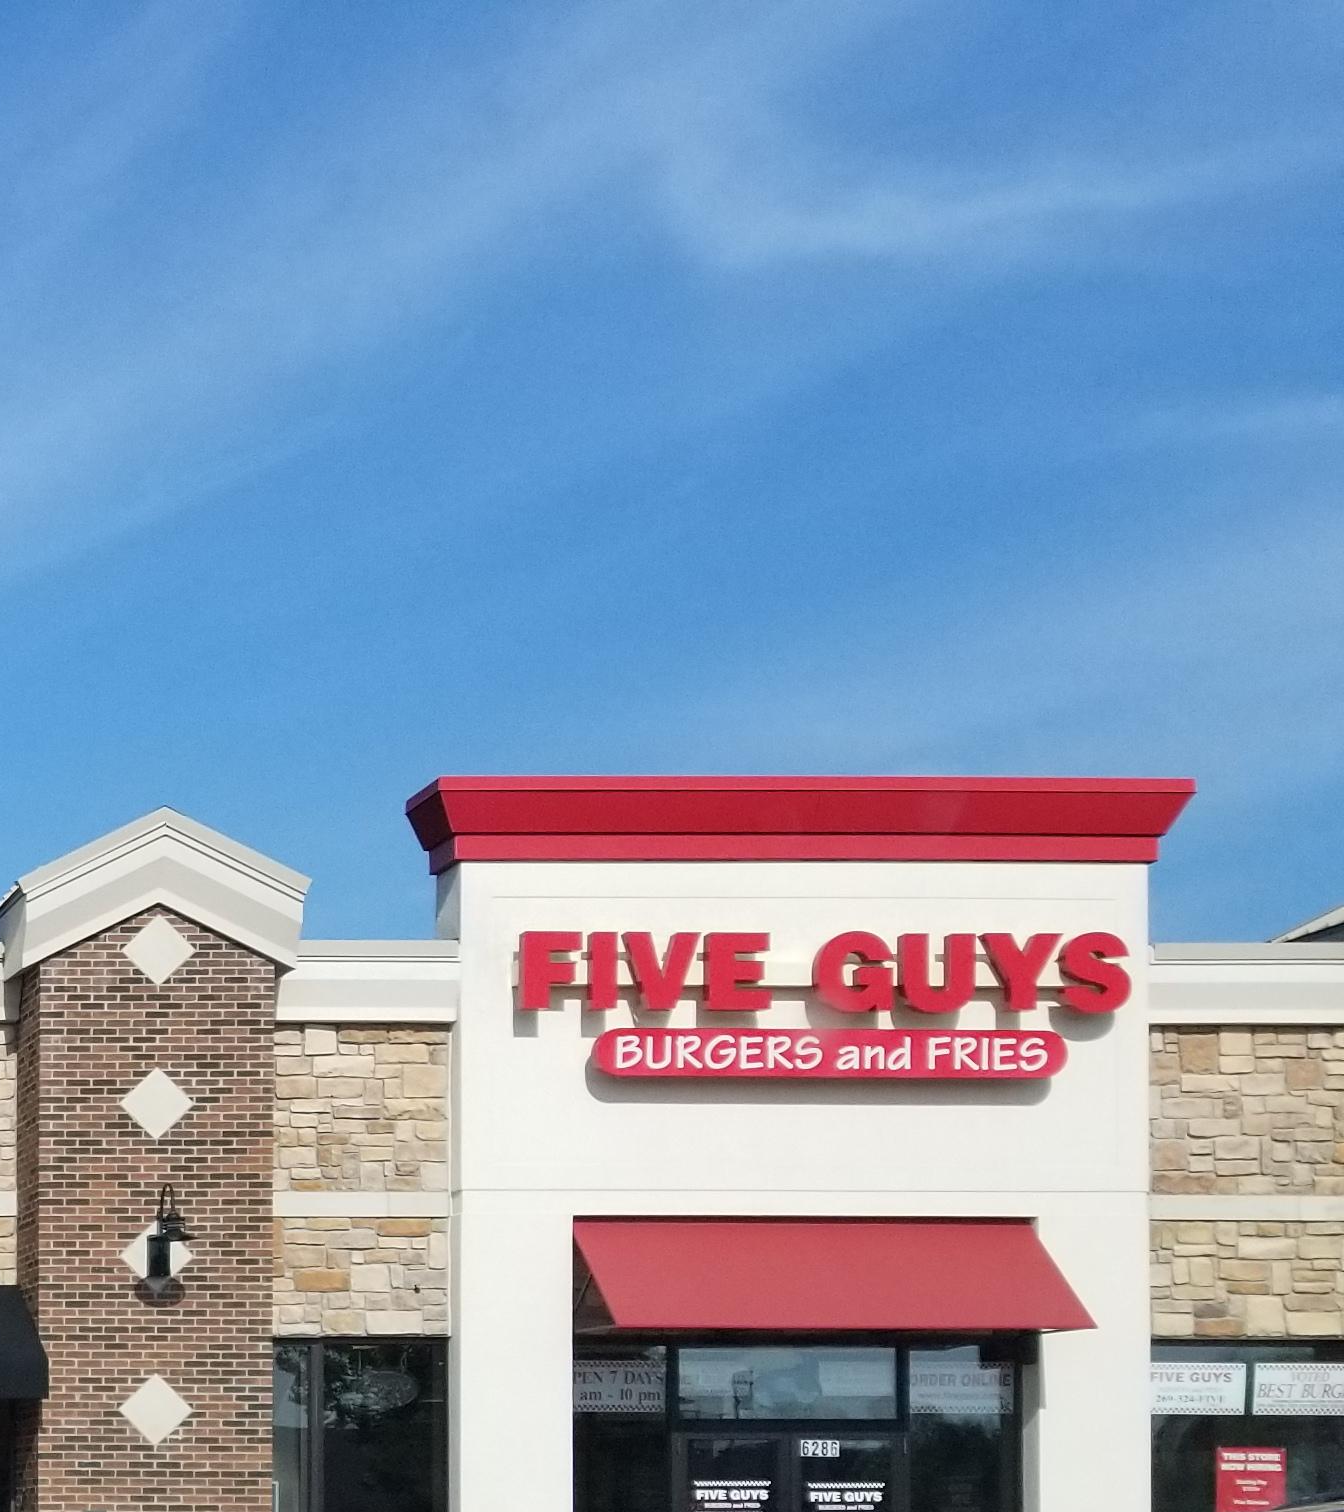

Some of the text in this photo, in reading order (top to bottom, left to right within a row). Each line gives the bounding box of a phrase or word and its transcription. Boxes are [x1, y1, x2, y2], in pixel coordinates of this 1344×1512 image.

[518, 931, 1133, 1014] FIVE GUYS
[615, 1036, 1050, 1072] BURGERS and FRIES
[573, 1370, 664, 1384] PEN 7 DAYS
[1151, 1372, 1232, 1383] FIVE GUYS
[579, 1391, 602, 1401] am
[620, 1388, 632, 1401] 10
[638, 1391, 660, 1404] pm
[1256, 1383, 1344, 1399] BEST BURG
[802, 1441, 838, 1456] 6286
[696, 1489, 769, 1500] FIVE GUYS
[809, 1491, 883, 1502] FIVE GUYS
